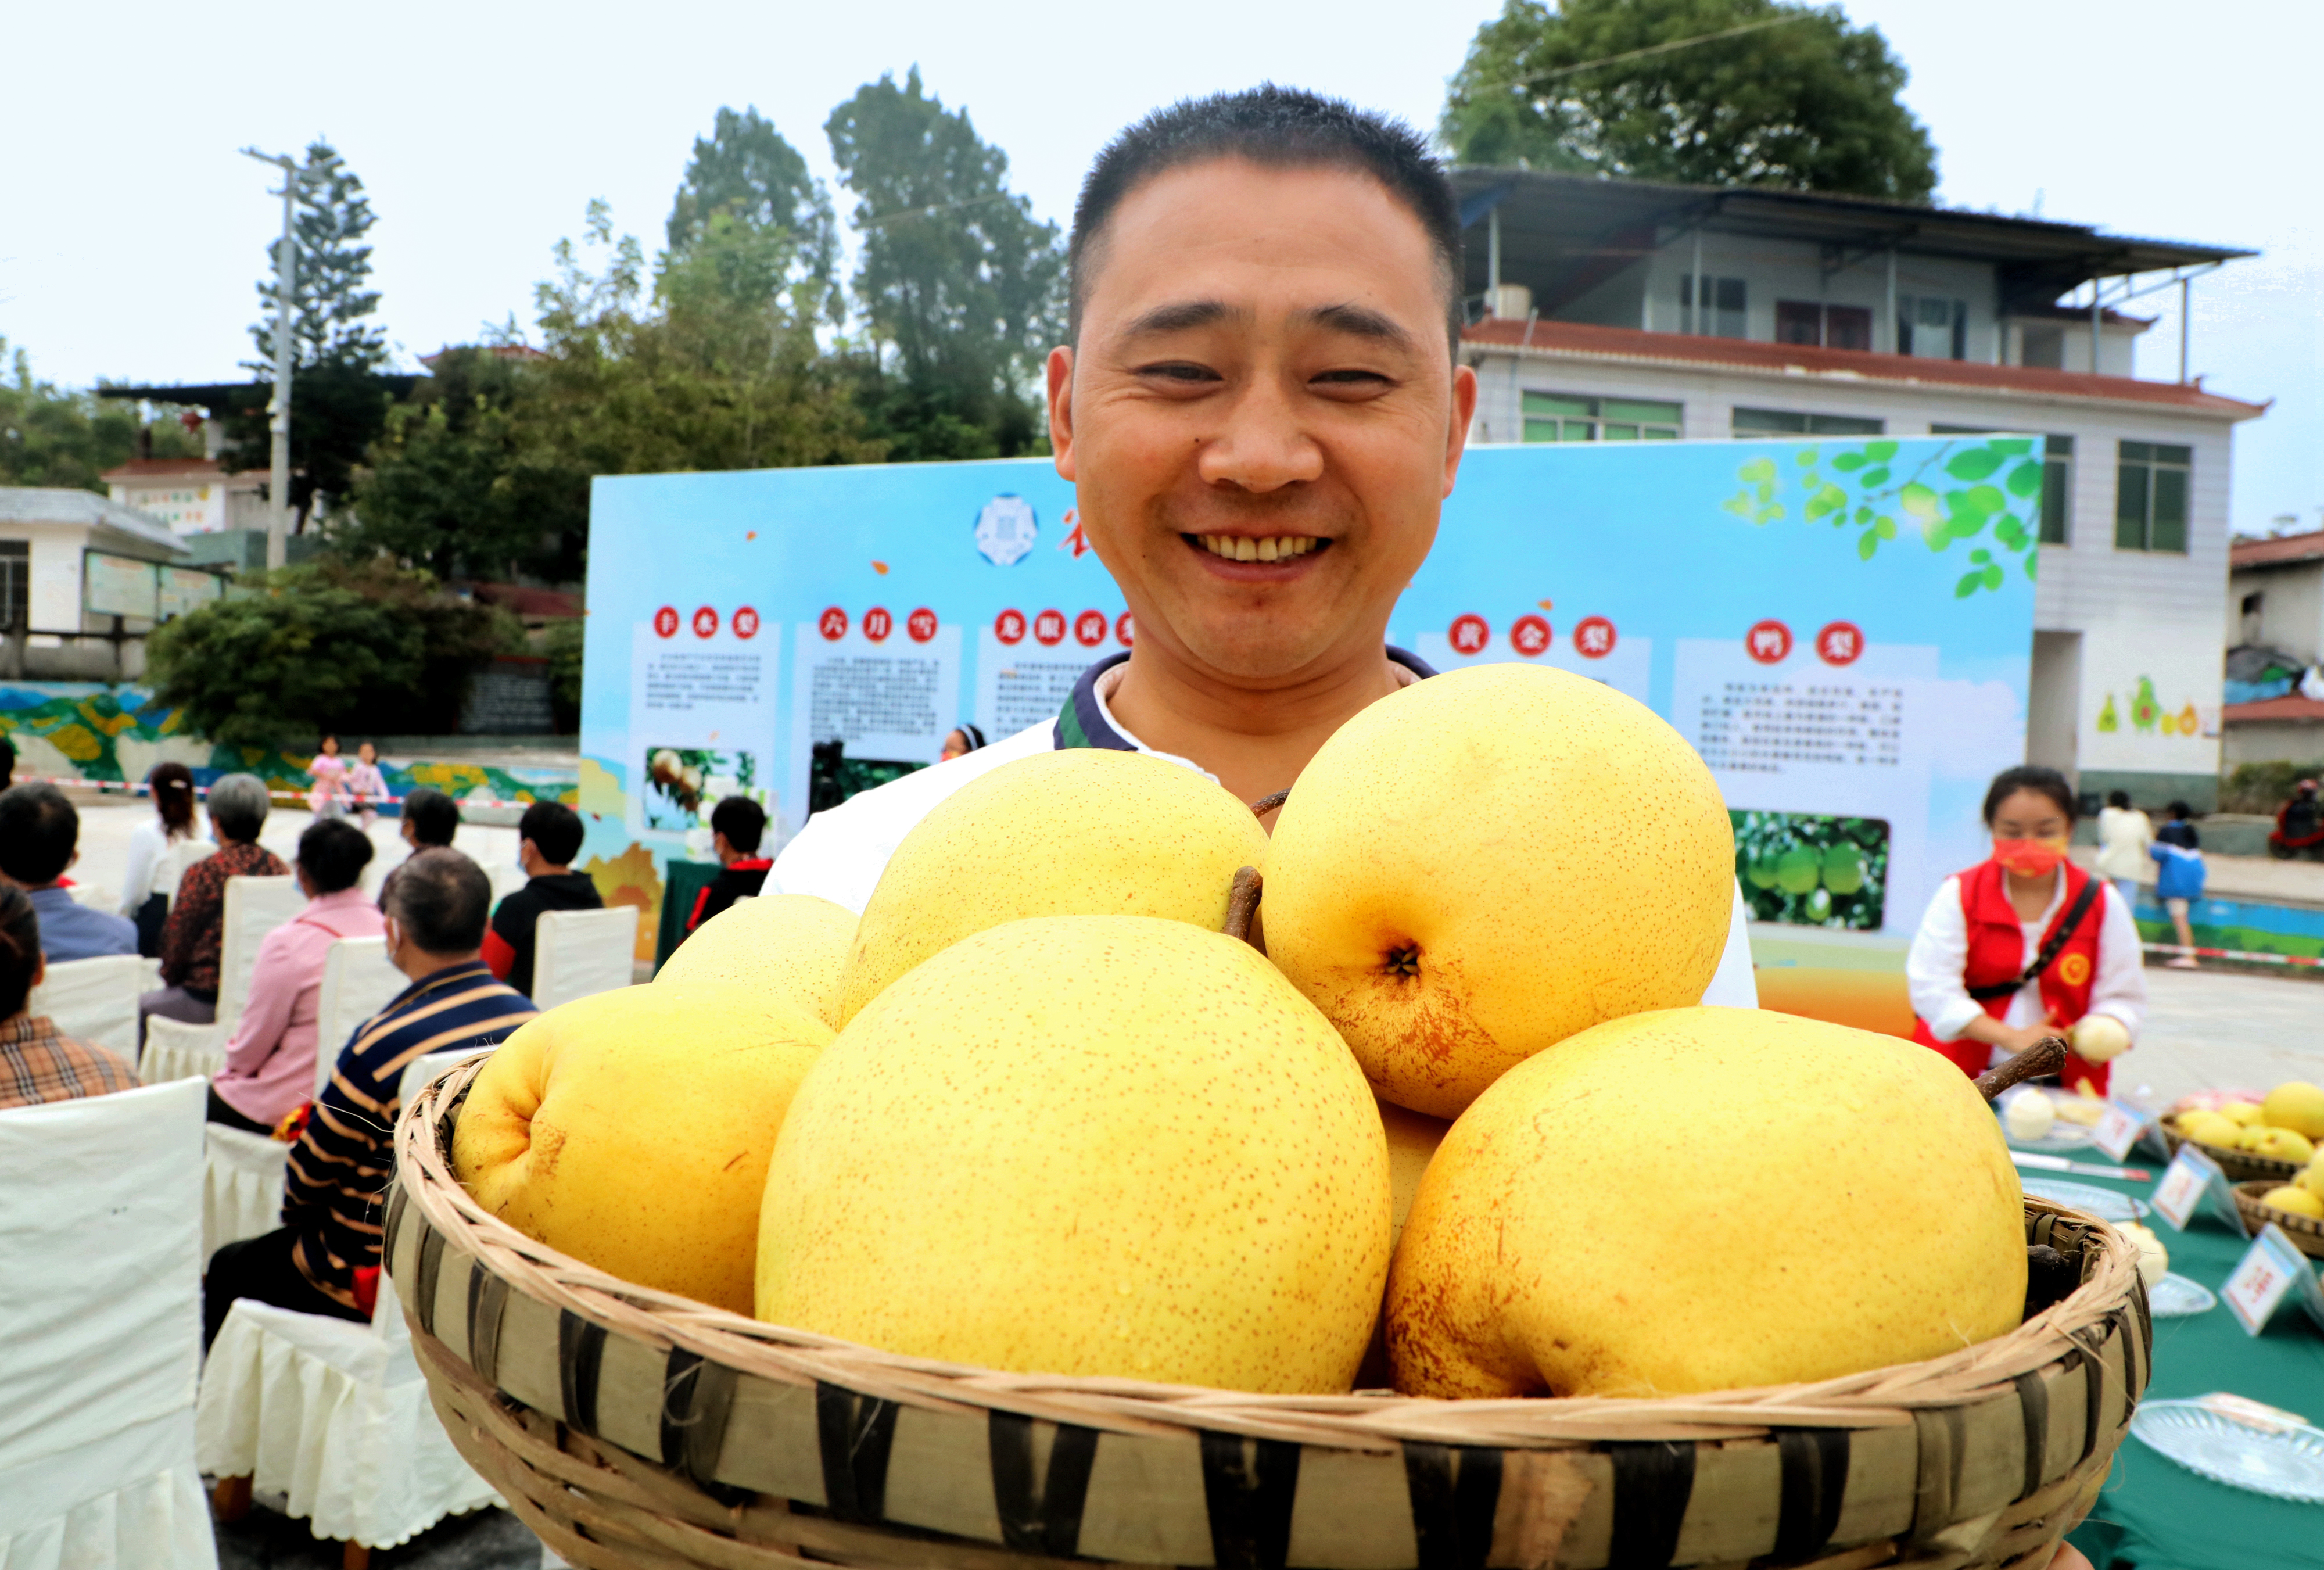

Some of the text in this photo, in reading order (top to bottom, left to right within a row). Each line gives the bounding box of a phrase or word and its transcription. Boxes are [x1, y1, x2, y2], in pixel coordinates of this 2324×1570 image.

[822, 612, 934, 637] 六月雪
[1457, 621, 1609, 652] 黄金梨
[1752, 629, 1854, 658] 鸭梨
